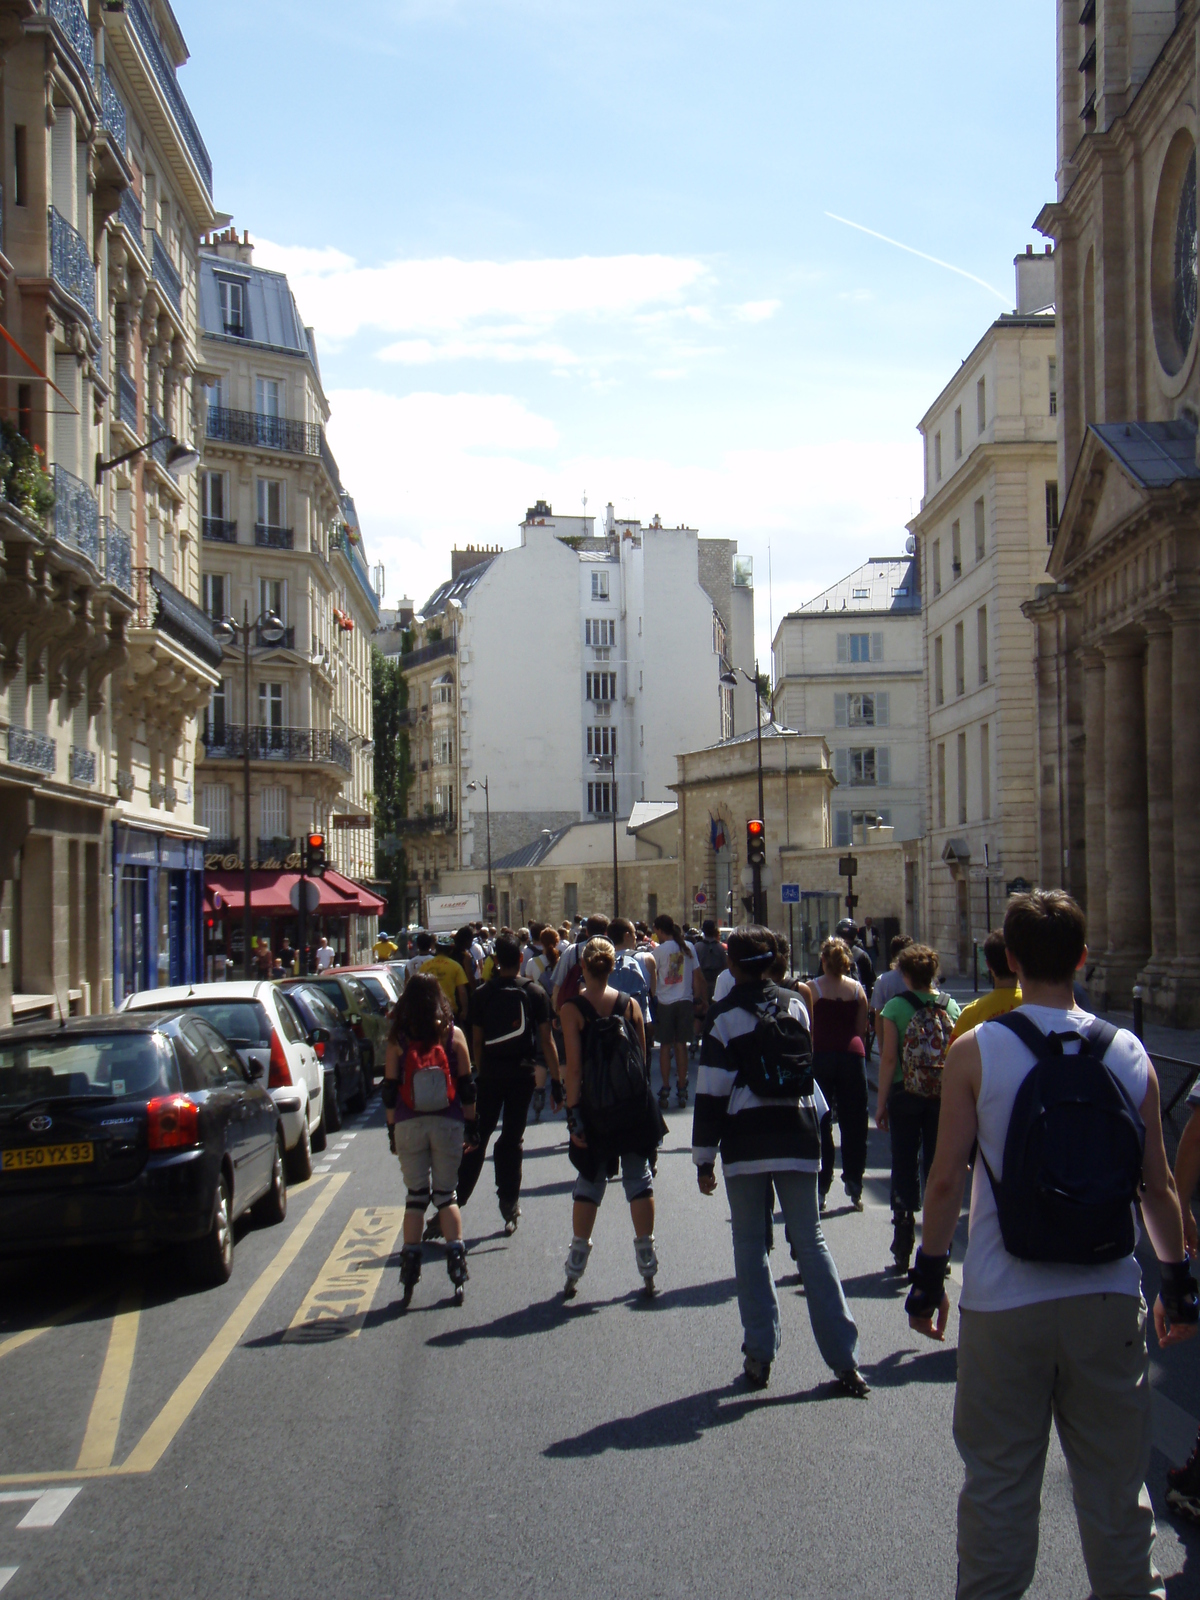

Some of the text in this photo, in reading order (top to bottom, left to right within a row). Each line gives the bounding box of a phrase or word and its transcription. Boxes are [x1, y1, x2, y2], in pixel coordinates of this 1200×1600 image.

[261, 857, 281, 869] du
[4, 1144, 91, 1167] 2150 YX 93
